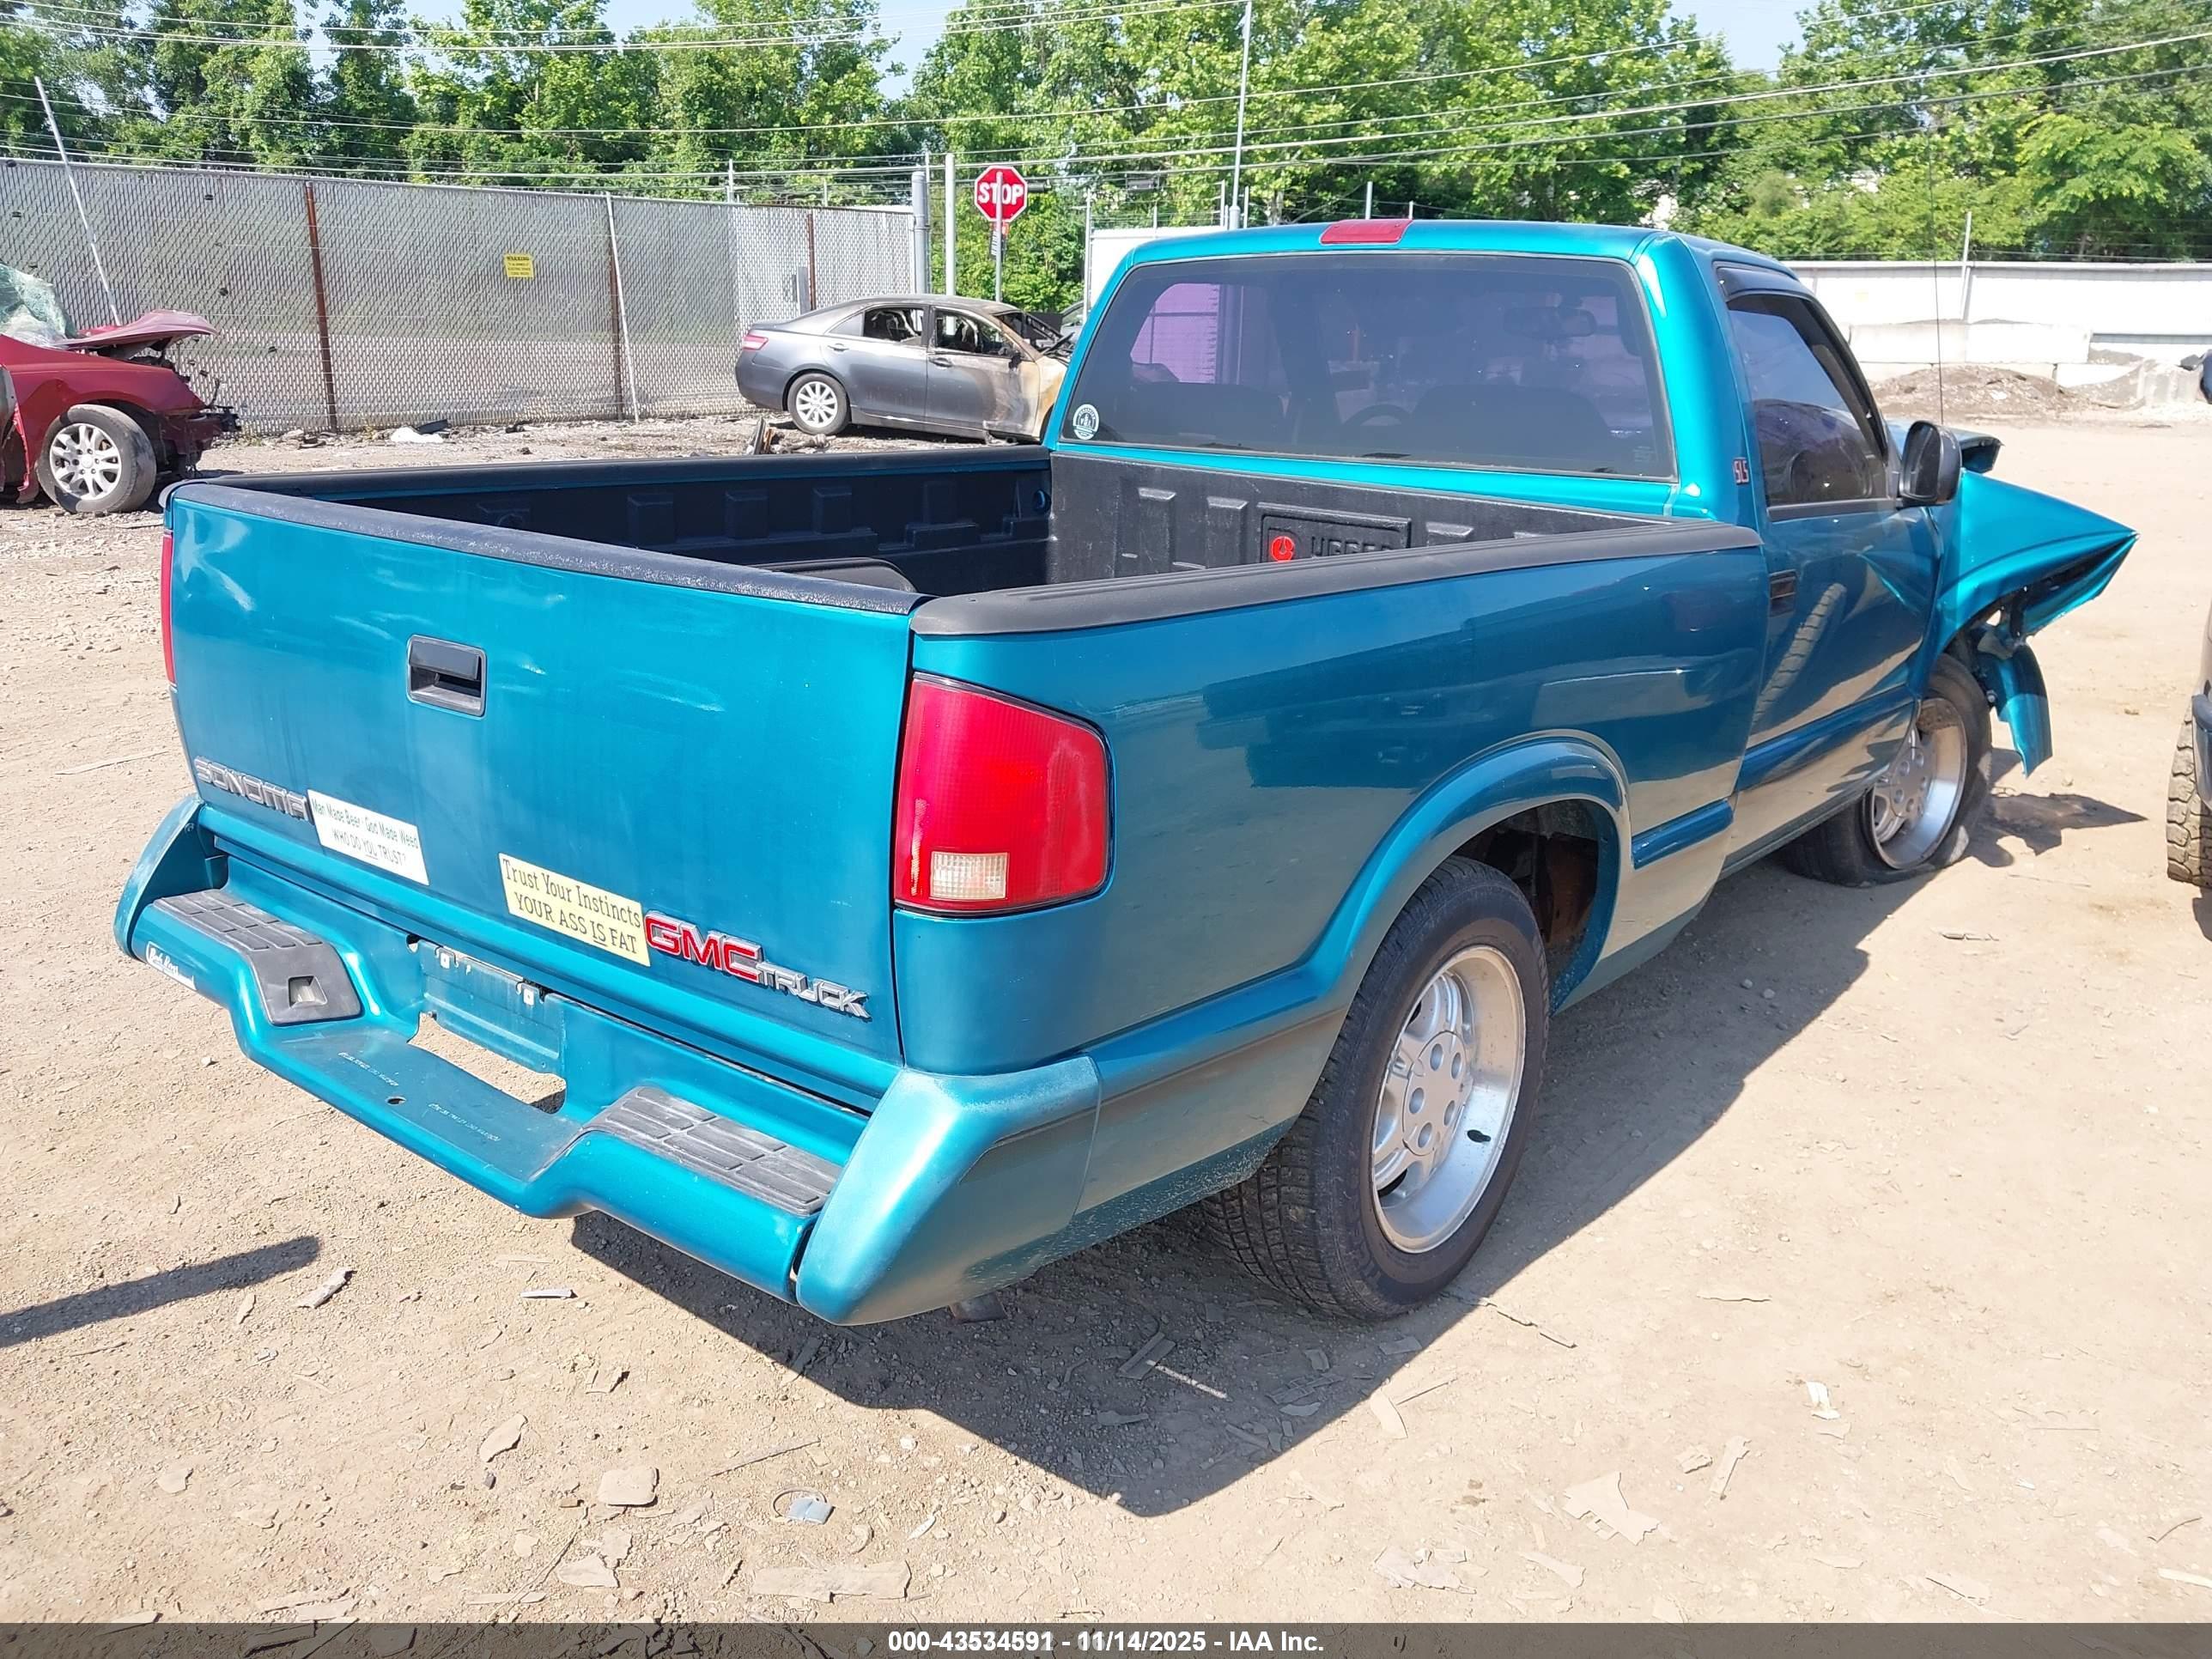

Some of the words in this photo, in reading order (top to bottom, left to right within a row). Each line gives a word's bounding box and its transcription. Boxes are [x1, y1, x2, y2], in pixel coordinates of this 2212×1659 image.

[978, 181, 1024, 205] STOP
[194, 756, 309, 821] SONOMA
[311, 798, 327, 816] Man
[325, 803, 345, 823] Made
[364, 816, 379, 836] God
[378, 821, 398, 842] Made
[398, 829, 419, 849] Weed
[331, 827, 350, 846] WHO
[349, 834, 362, 851] DO
[362, 838, 378, 858] YOU
[377, 844, 406, 866] TRUST?
[502, 858, 539, 890] Trust
[541, 872, 572, 902] Your
[575, 885, 641, 928] Instincts
[514, 891, 556, 923] YOUR
[559, 908, 587, 934] ASS
[589, 921, 608, 943] IS
[609, 927, 637, 953] FAT
[645, 909, 765, 983] GMC
[758, 959, 872, 1020] TRUCK
